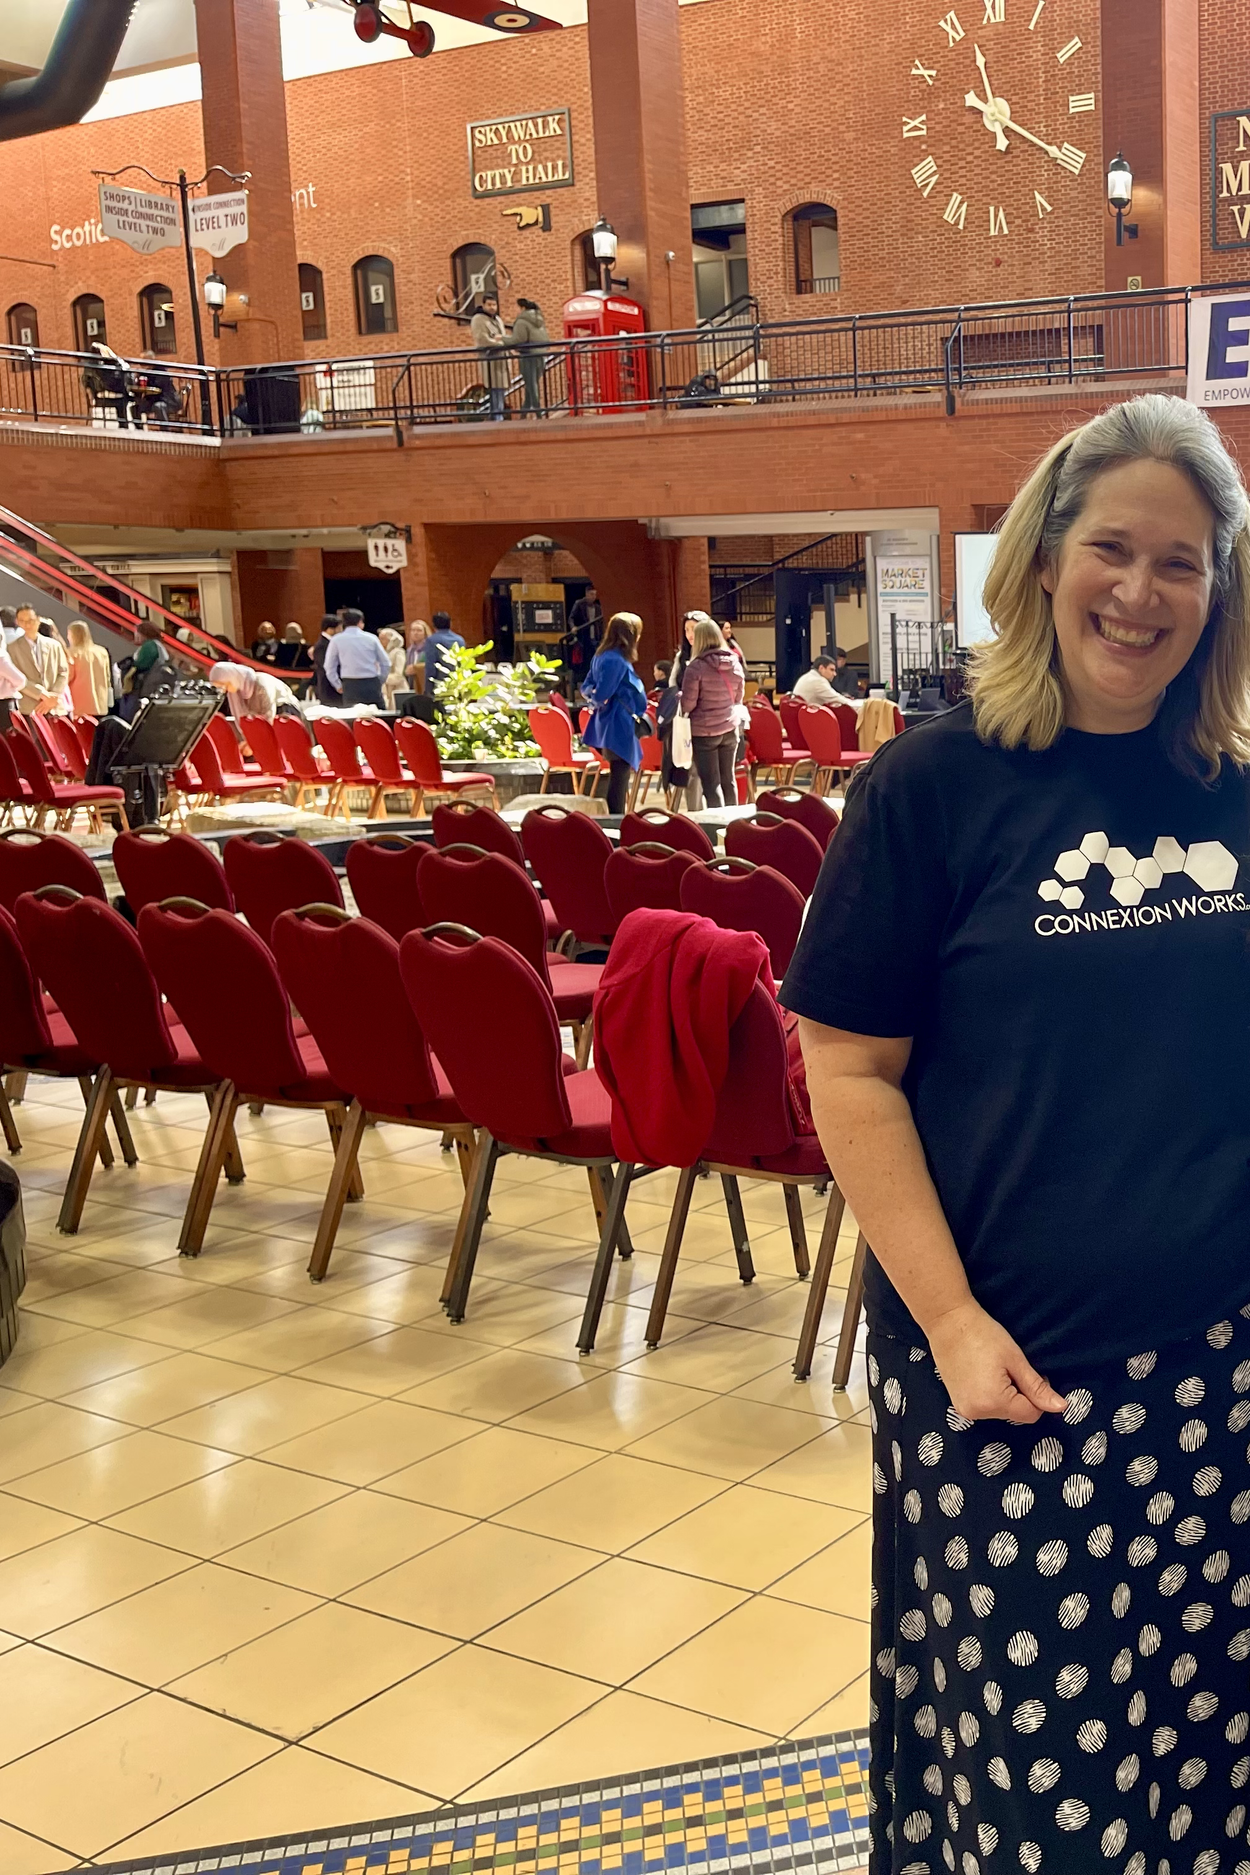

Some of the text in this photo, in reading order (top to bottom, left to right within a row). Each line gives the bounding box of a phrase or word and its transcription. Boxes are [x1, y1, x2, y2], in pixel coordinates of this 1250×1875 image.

[911, 59, 937, 86] X
[474, 115, 562, 147] SKYWALK
[508, 142, 532, 164] TO
[474, 160, 569, 191] CITY HALL
[103, 190, 175, 214] SHOPS LIBRARY
[194, 198, 245, 213] INSIDE CONNECTION
[105, 204, 177, 226] INSIDE CONNECTION
[194, 212, 246, 232] LEVEL TWO
[117, 219, 166, 238] LEVEL TWO
[881, 568, 928, 579] MARKET
[881, 579, 925, 590] SQUARE
[1034, 902, 1172, 936] CONNEXION
